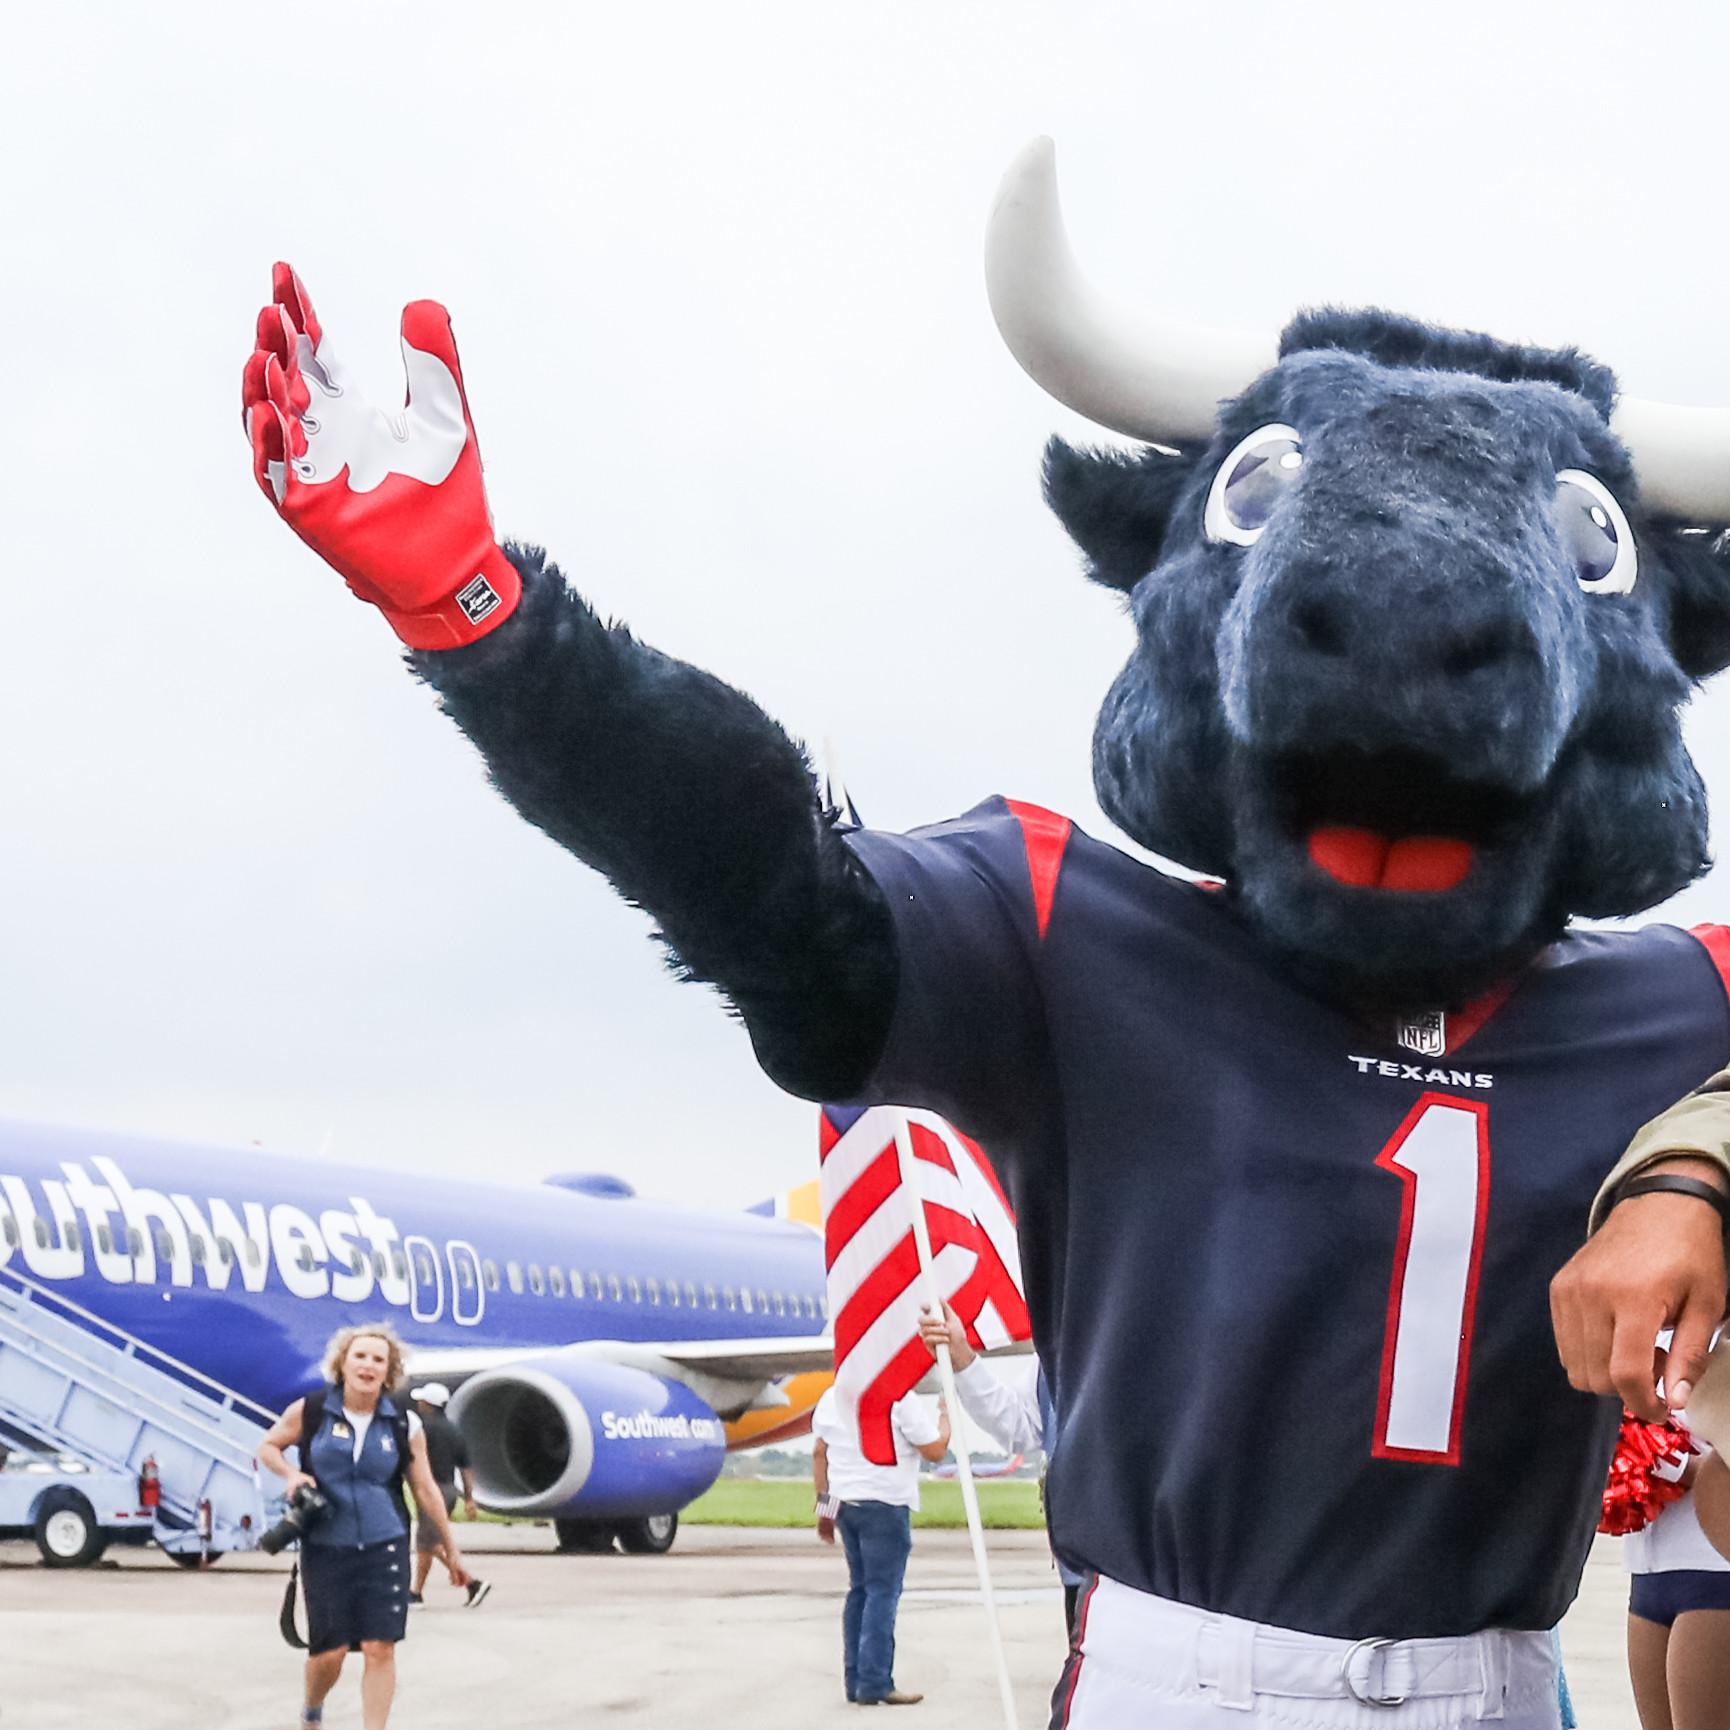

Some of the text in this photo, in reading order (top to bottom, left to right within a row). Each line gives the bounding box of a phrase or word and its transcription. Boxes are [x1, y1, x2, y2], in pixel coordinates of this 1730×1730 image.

[1347, 1055, 1494, 1089] TEXANS
[1407, 1027, 1438, 1049] NFL
[0, 1154, 412, 1306] uthwest
[1371, 1091, 1490, 1466] 1
